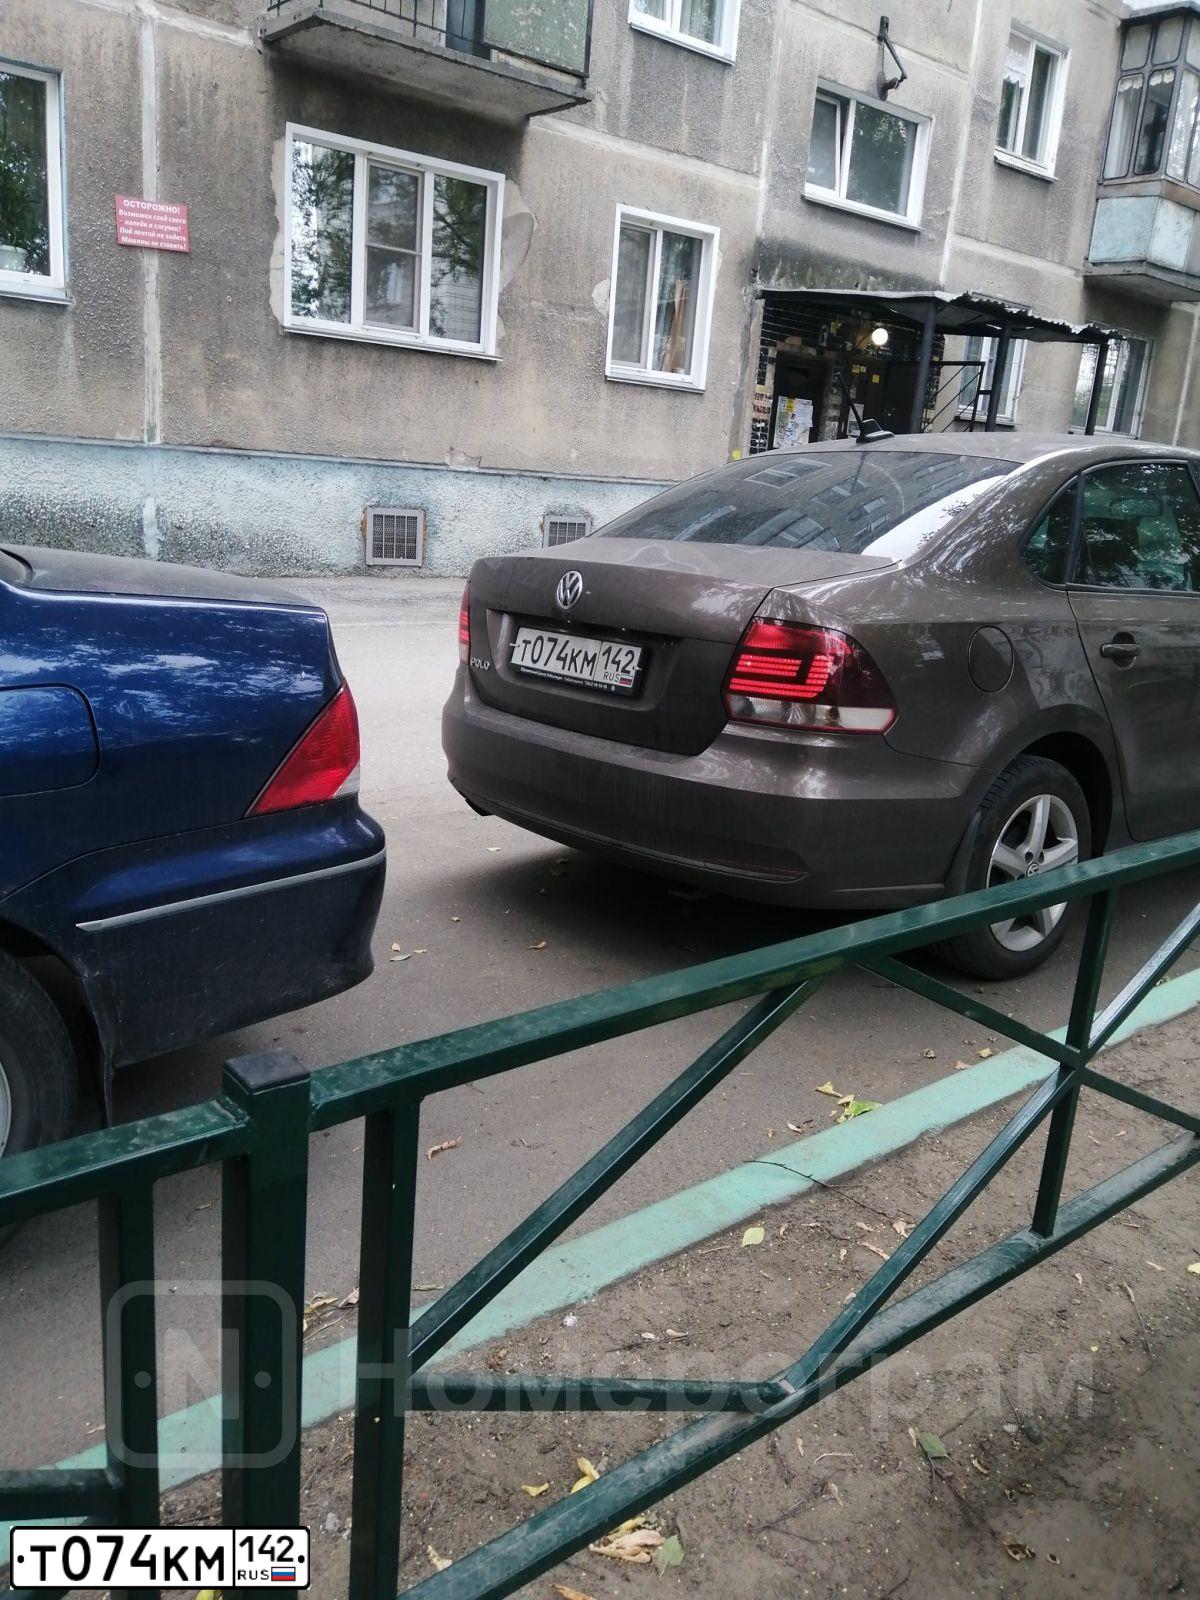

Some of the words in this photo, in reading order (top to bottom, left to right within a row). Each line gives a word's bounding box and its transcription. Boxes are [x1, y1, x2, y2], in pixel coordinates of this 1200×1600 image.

[123, 200, 180, 214] ОСТОРОЖНО!
[119, 209, 152, 219] Возможен
[153, 214, 168, 222] сход
[168, 216, 186, 224] снега
[124, 220, 148, 229] наледи
[121, 236, 150, 245] Машины
[159, 240, 187, 250] ставить!
[522, 635, 598, 676] Т074КМ
[602, 645, 635, 674] 142
[604, 671, 620, 683] RUS
